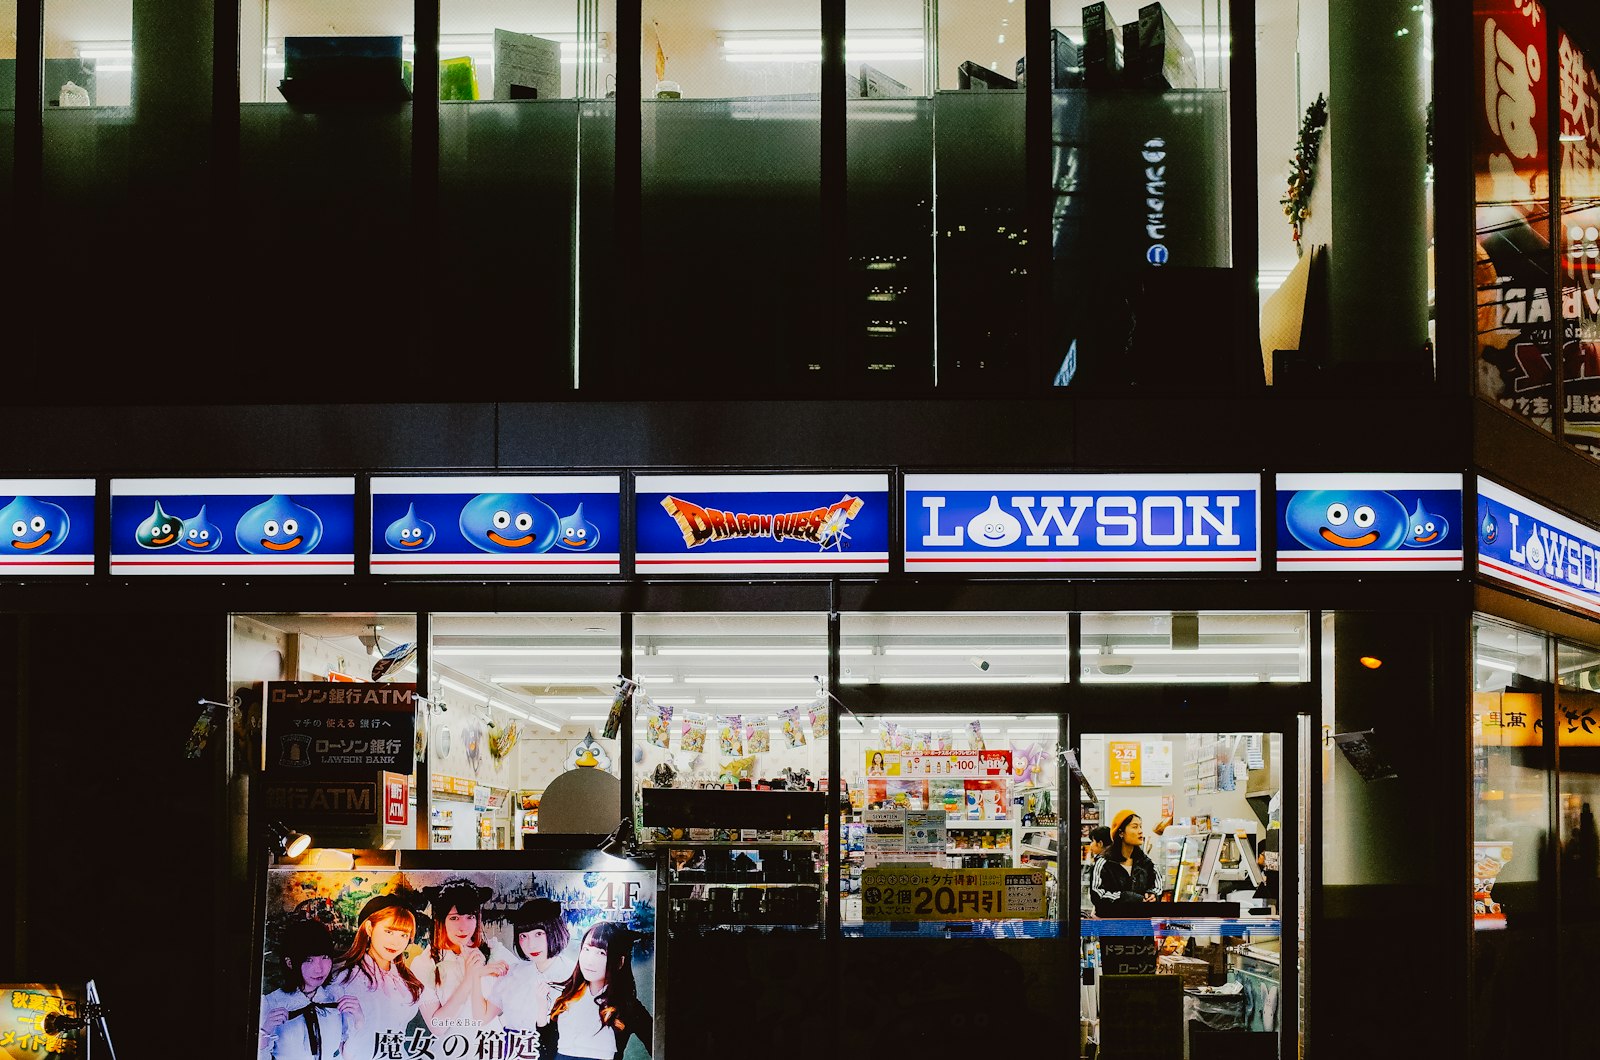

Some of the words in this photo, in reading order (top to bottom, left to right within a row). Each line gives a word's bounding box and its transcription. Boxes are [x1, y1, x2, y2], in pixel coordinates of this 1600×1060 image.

[660, 495, 772, 548] DRAGON
[773, 495, 864, 543] QUEST
[922, 495, 1240, 547] LWSON
[1509, 512, 1600, 592] LWSO
[272, 688, 412, 705] ローソン銀行ATM
[315, 739, 402, 755] ローソン銀行
[321, 755, 363, 764] LAWSON
[366, 755, 395, 764] BANK
[390, 803, 404, 817] ATM
[596, 882, 641, 910] 4F
[883, 888, 912, 905] 2個
[914, 886, 1002, 915] 20円引
[431, 1017, 483, 1027] Cafe&Bar
[371, 1029, 541, 1060] 魔女の箱庭
